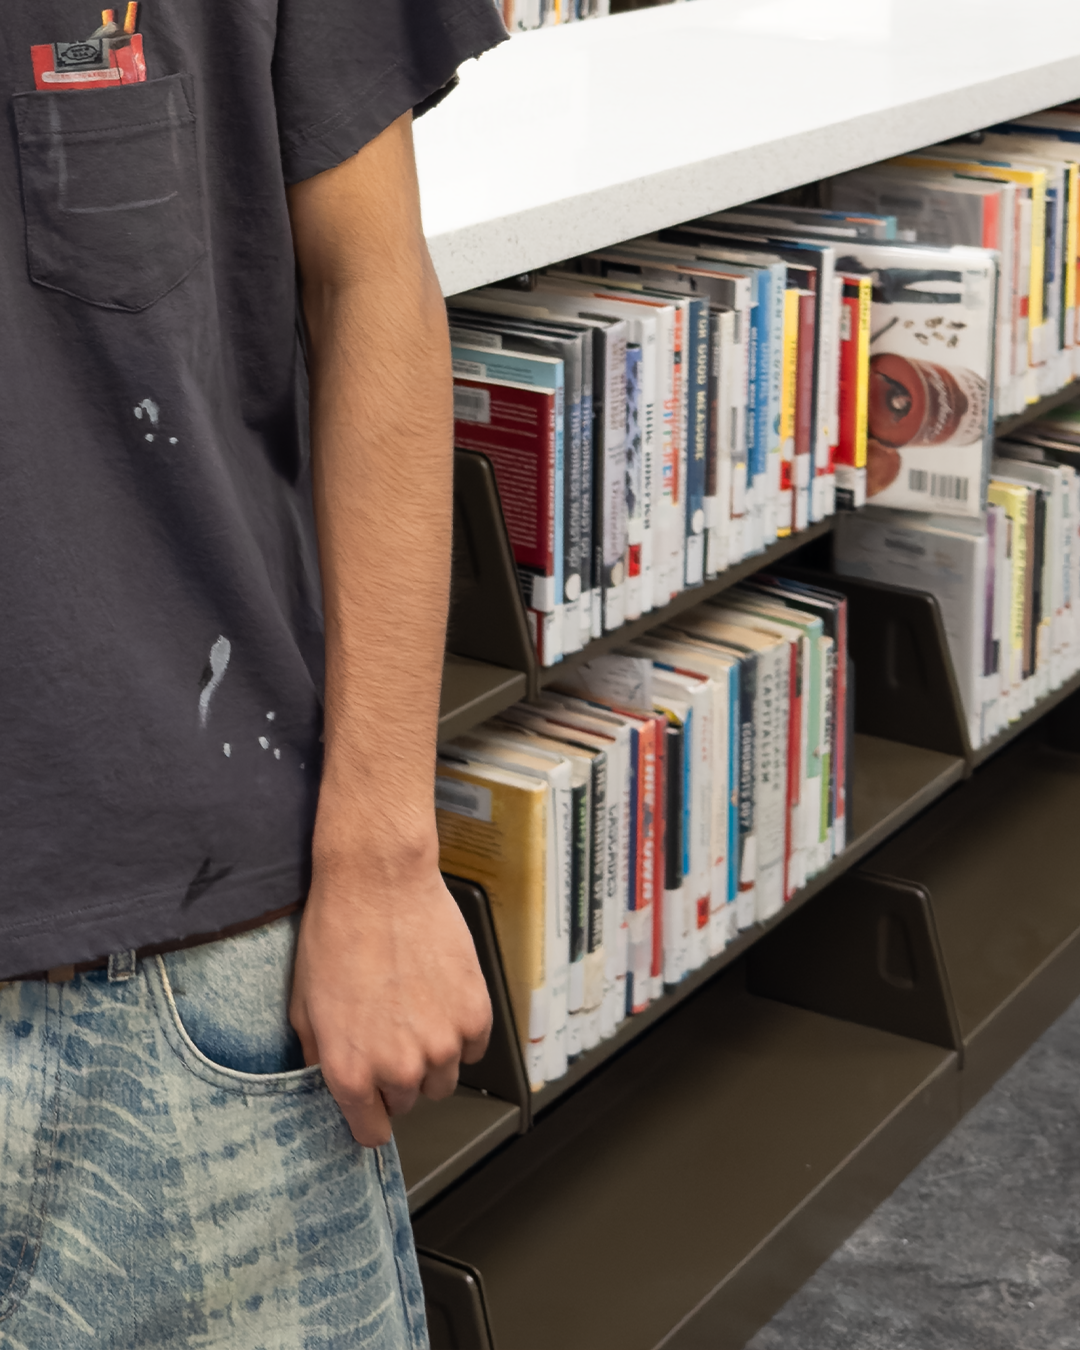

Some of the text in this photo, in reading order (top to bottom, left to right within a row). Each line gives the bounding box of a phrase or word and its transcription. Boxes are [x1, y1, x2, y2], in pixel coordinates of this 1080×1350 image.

[694, 309, 707, 461] FOR GOOD MEASURE
[568, 412, 580, 568] THE CHINESE MUST GO
[582, 434, 590, 490] CHINESE
[644, 403, 654, 530] little america
[663, 399, 674, 497] DIFFERENT
[582, 494, 590, 532] MUST
[742, 722, 752, 797] ECONOMISTS
[761, 674, 772, 783] CAPITALISM
